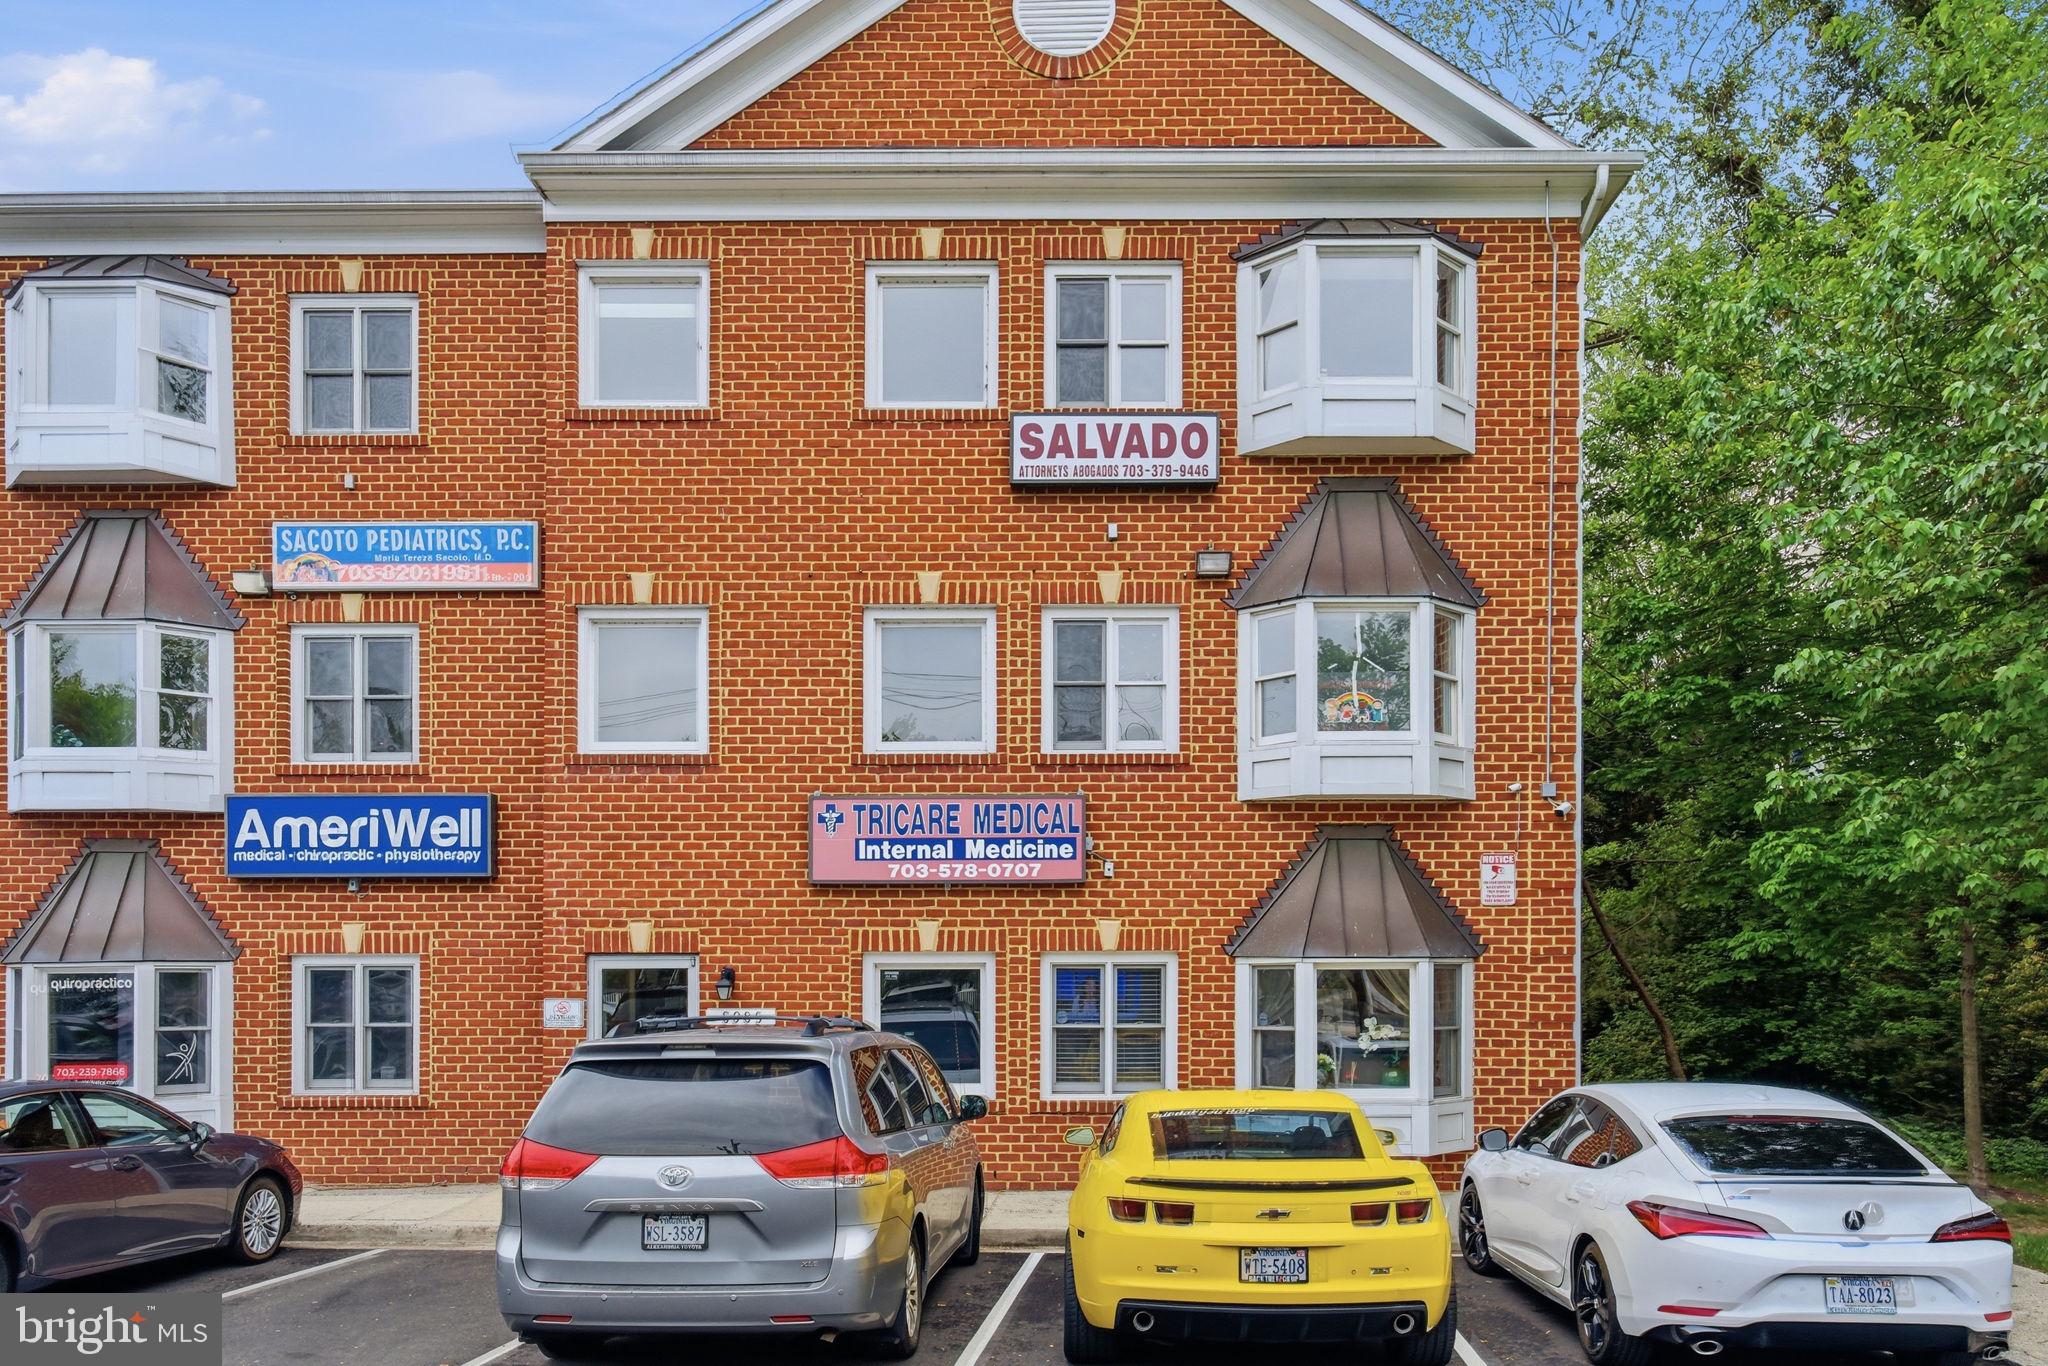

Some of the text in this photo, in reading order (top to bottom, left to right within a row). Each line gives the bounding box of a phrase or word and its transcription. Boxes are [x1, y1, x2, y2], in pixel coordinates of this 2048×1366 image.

[1019, 422, 1209, 460] SALVADO
[1019, 464, 1209, 478] ATTORNEYS ABOGADOS 703-379-9446
[280, 528, 531, 554] SACOTO PEDIATRICS, P.C.
[852, 802, 1081, 835] TRICARE MEDICAL
[234, 808, 482, 848] AmeriWell
[233, 848, 482, 864] medical chiropractic physiotherapy
[858, 839, 1074, 860] Internal Medicine
[1482, 855, 1515, 864] NOTICE
[887, 863, 1042, 878] 703-578-0707
[646, 1225, 704, 1242] WSL-3587
[1244, 1258, 1305, 1275] WTE-5408
[1829, 1286, 1893, 1304] TAA-8023
